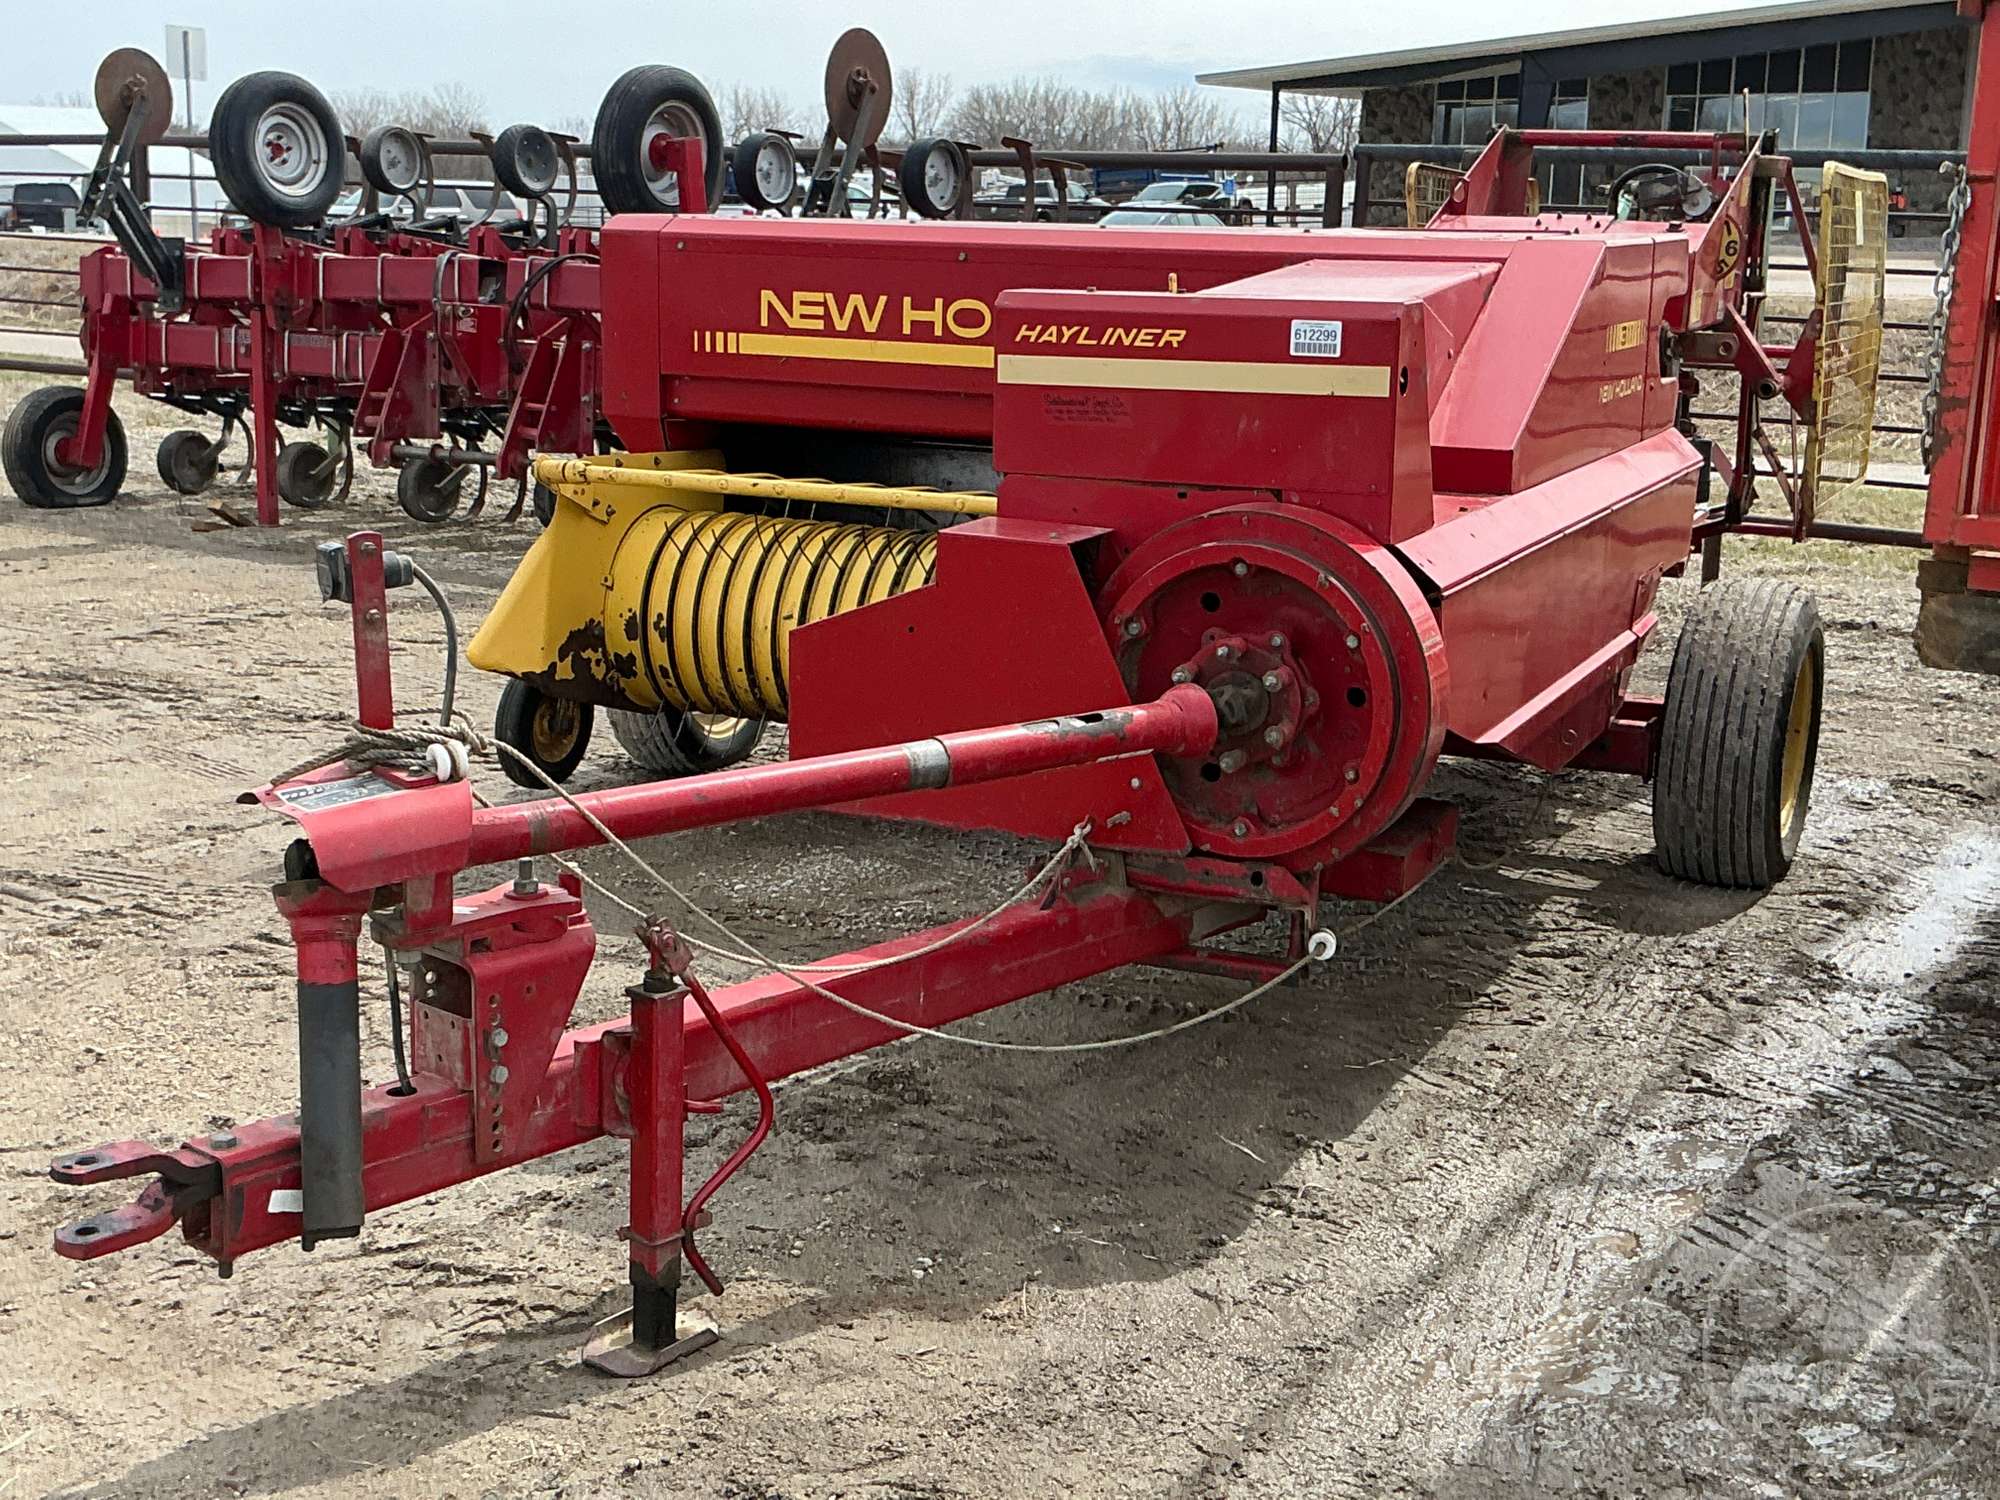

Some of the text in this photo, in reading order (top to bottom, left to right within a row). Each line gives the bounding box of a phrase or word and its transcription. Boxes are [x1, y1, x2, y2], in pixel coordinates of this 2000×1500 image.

[760, 289, 992, 338] NEW HO
[1014, 324, 1187, 348] HAYLINER
[1294, 328, 1337, 342] 612299
